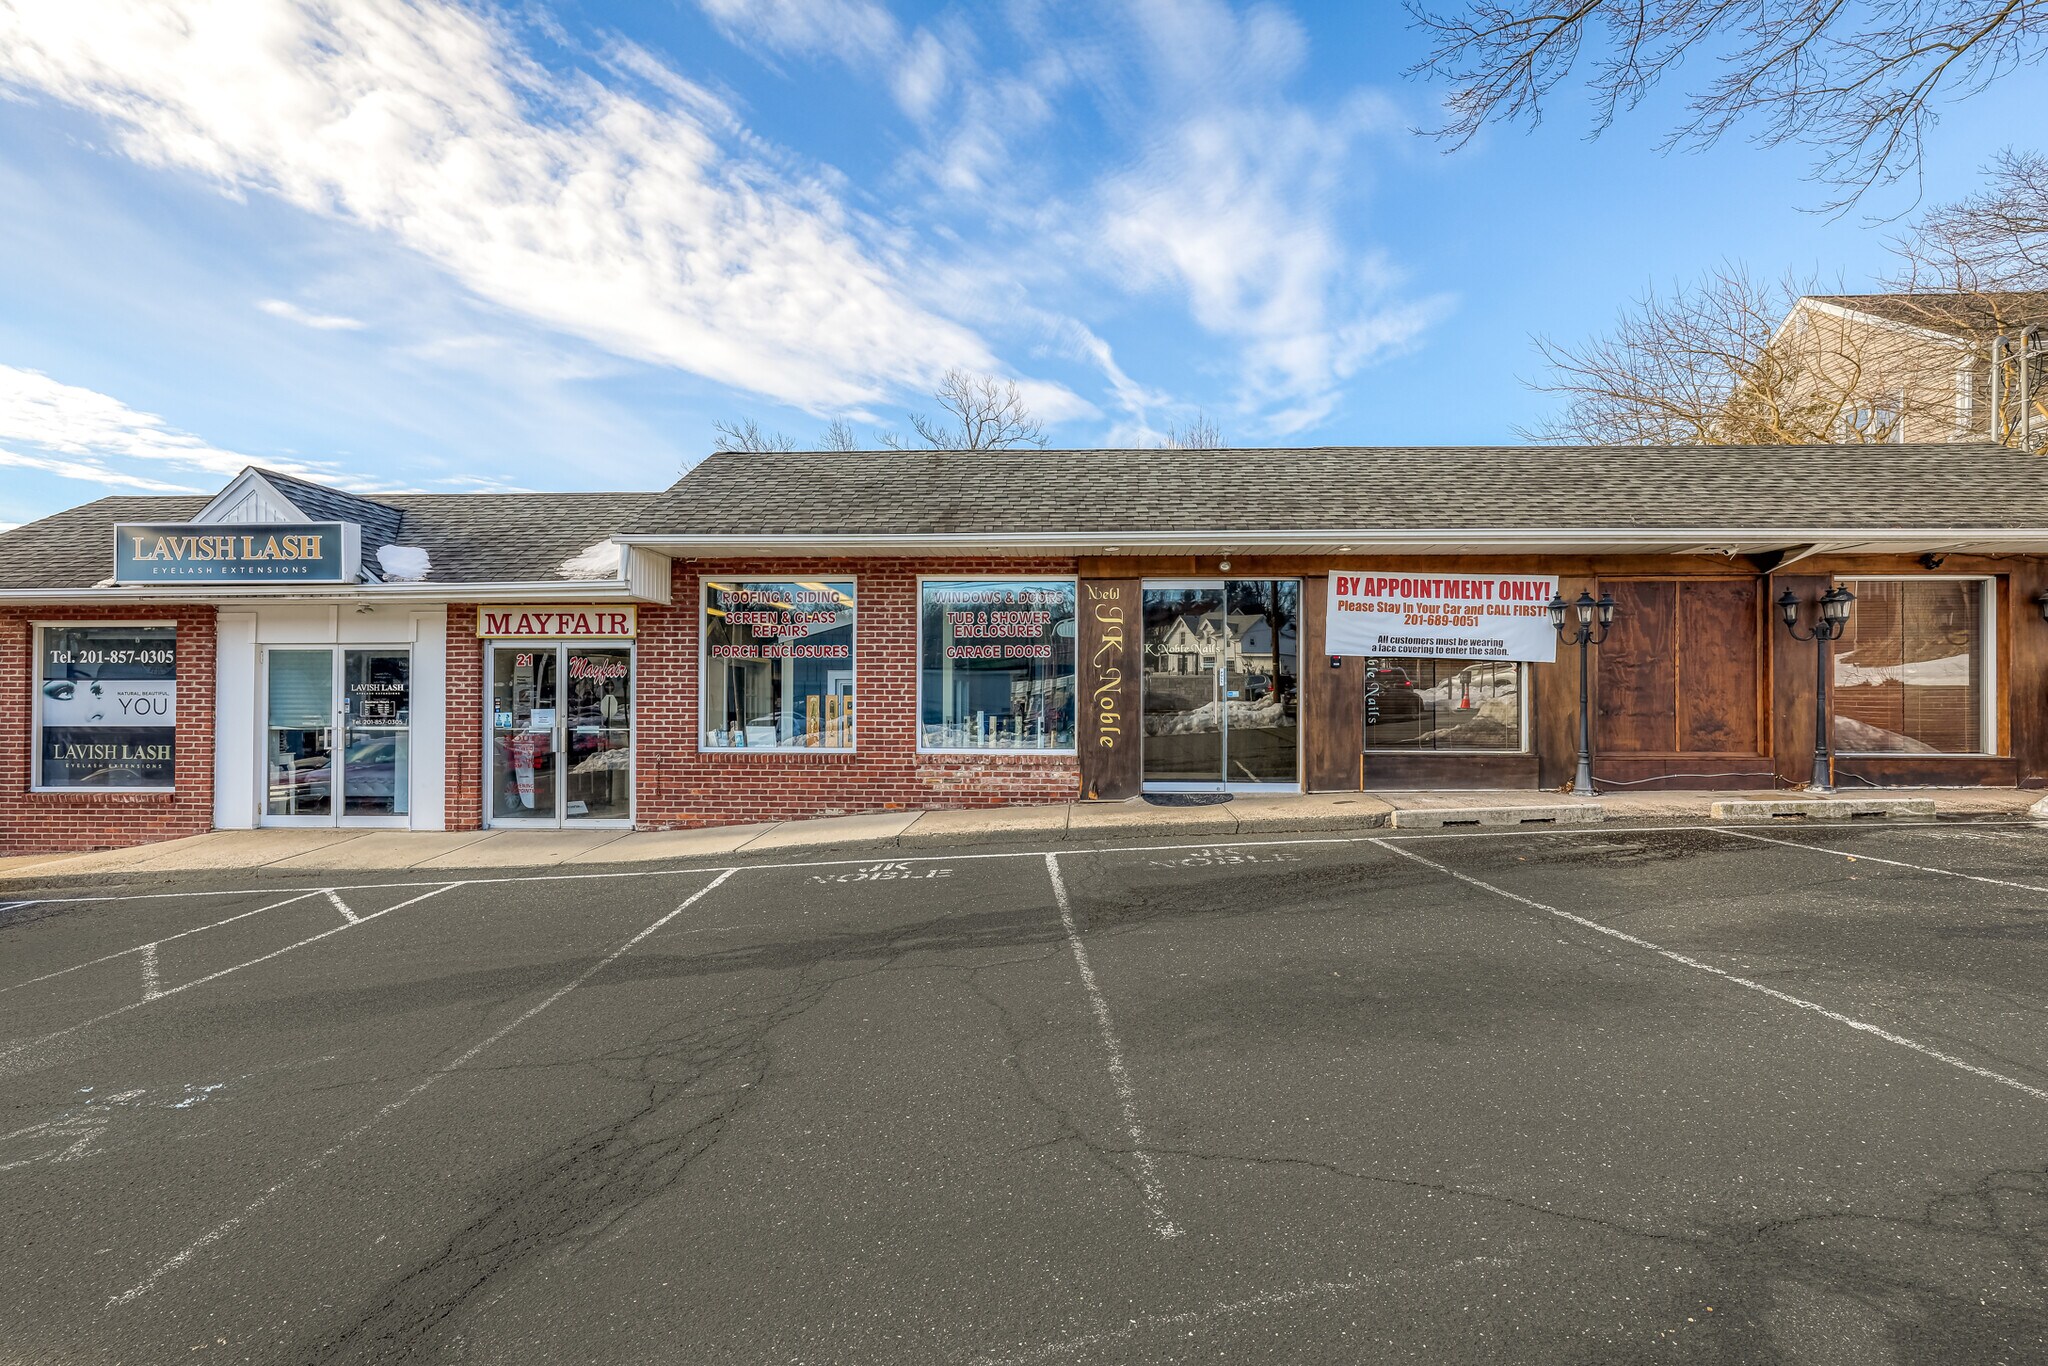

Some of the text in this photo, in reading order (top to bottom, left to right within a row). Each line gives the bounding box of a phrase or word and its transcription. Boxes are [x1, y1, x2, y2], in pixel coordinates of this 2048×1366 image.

[132, 535, 323, 561] LAVISH LASH
[153, 566, 308, 574] EYELASH EXTENSIONS
[1336, 577, 1551, 601] BY APPOINTMENT ONLY!
[722, 590, 840, 604] ROOFING & SIDING
[935, 590, 1064, 605] WINDOWS & DOORS
[1338, 600, 1547, 617] Please Stay In Your Car and CALL FIRST!
[484, 613, 629, 635] MAYFAIR
[725, 611, 836, 625] SCREEN & GLASS
[947, 611, 1051, 625] TUB & SHOWER
[1404, 614, 1479, 627] 201-689-0051
[752, 624, 808, 638] REPAIRS
[954, 624, 1043, 638] ENCLOSURES
[1377, 635, 1504, 648] All customers must be wearing
[50, 650, 174, 664] Tel. 201-857-0305
[712, 645, 849, 659] PORCH ENCLOSURES
[946, 645, 1051, 659] GARAGE DOORS
[1371, 644, 1509, 656] a face covering to enter the salon.
[516, 653, 533, 667] 21
[569, 656, 628, 686] Mayfair
[351, 683, 404, 692] LAVISH LASH
[118, 698, 168, 715] YOU
[1093, 667, 1122, 748] Noble
[54, 744, 172, 760] LAVISH LASH
